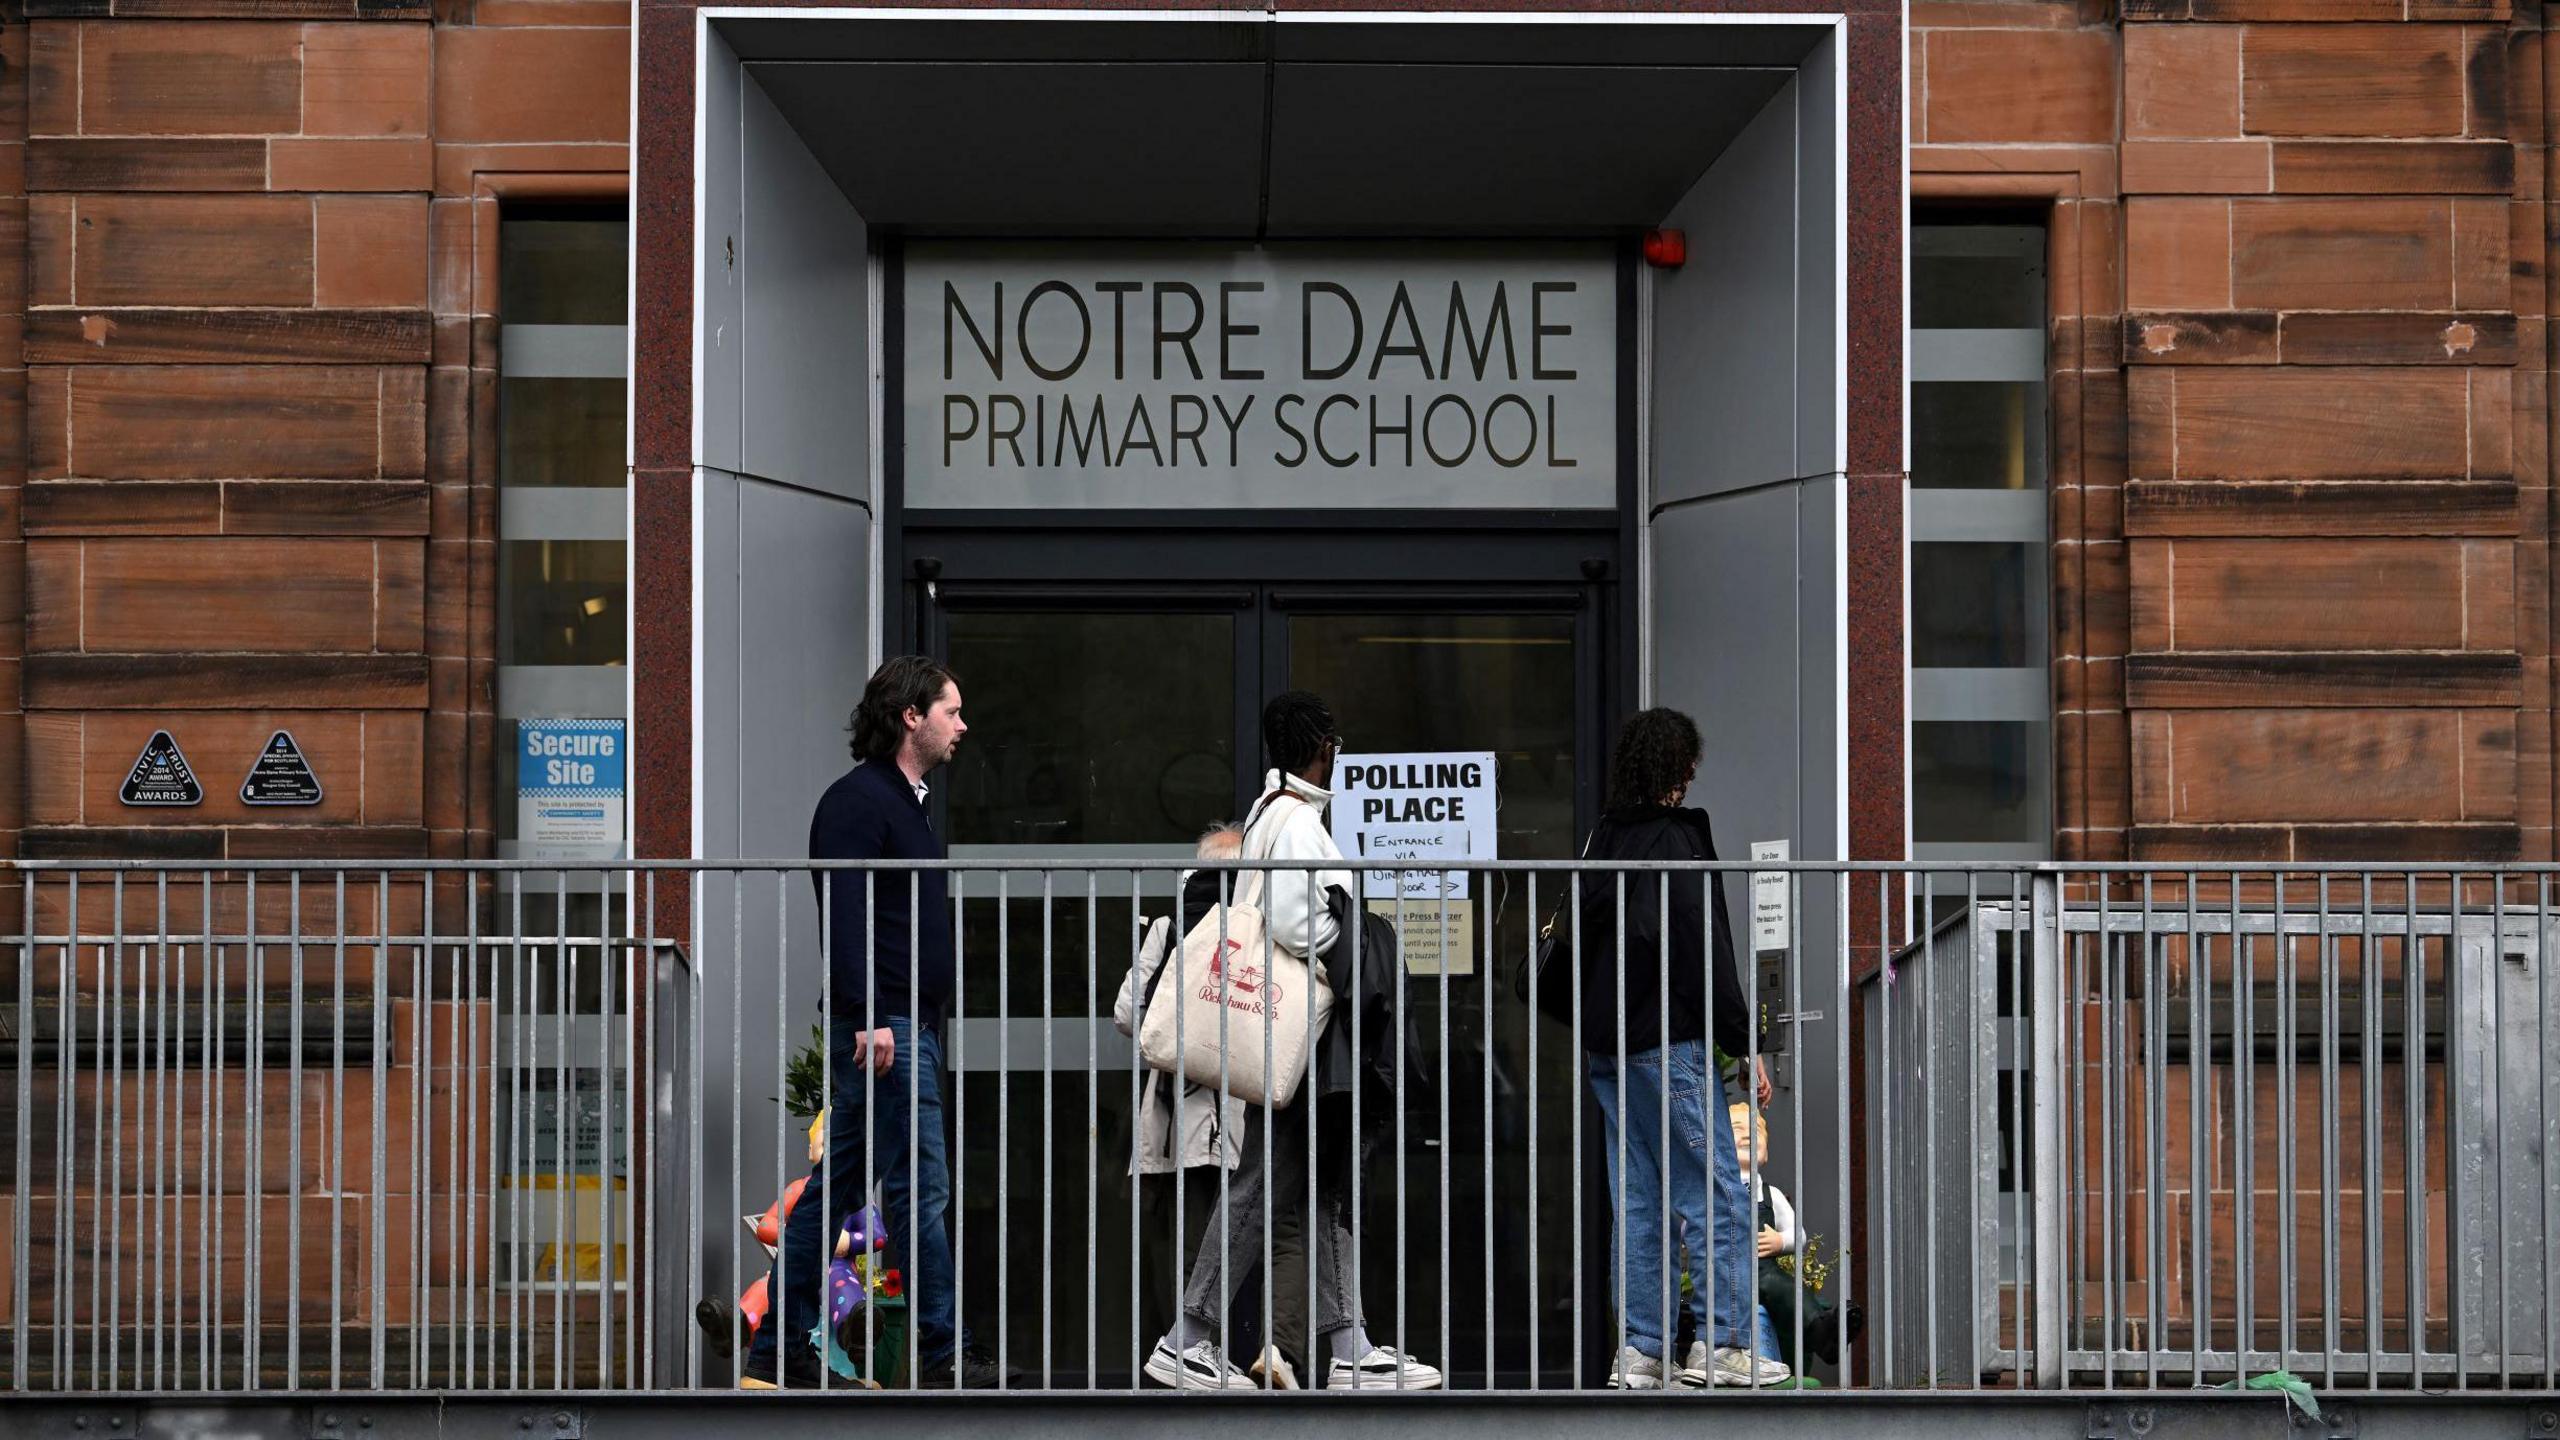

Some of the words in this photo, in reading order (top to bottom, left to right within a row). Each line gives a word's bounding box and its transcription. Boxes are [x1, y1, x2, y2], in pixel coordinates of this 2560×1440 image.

[943, 280, 1266, 381] NOTRE
[1302, 280, 1578, 381] DAME
[943, 393, 1256, 468] PRIMARY
[1274, 393, 1578, 468] SCHOOL
[527, 730, 615, 756] Secure
[132, 747, 158, 783] CIVIC
[166, 745, 192, 784] TRUST
[547, 759, 595, 785] Site
[1344, 763, 1481, 790] POLLING
[134, 791, 187, 800] AWARDS
[1363, 797, 1465, 823] PLACE
[1374, 835, 1444, 847] ENTRANCE
[1395, 851, 1416, 859] VIA
[1380, 912, 1407, 921] Pleae
[1409, 912, 1432, 920] Press
[1198, 985, 1251, 1012] Rickhaw
[1252, 1001, 1264, 1016] &
